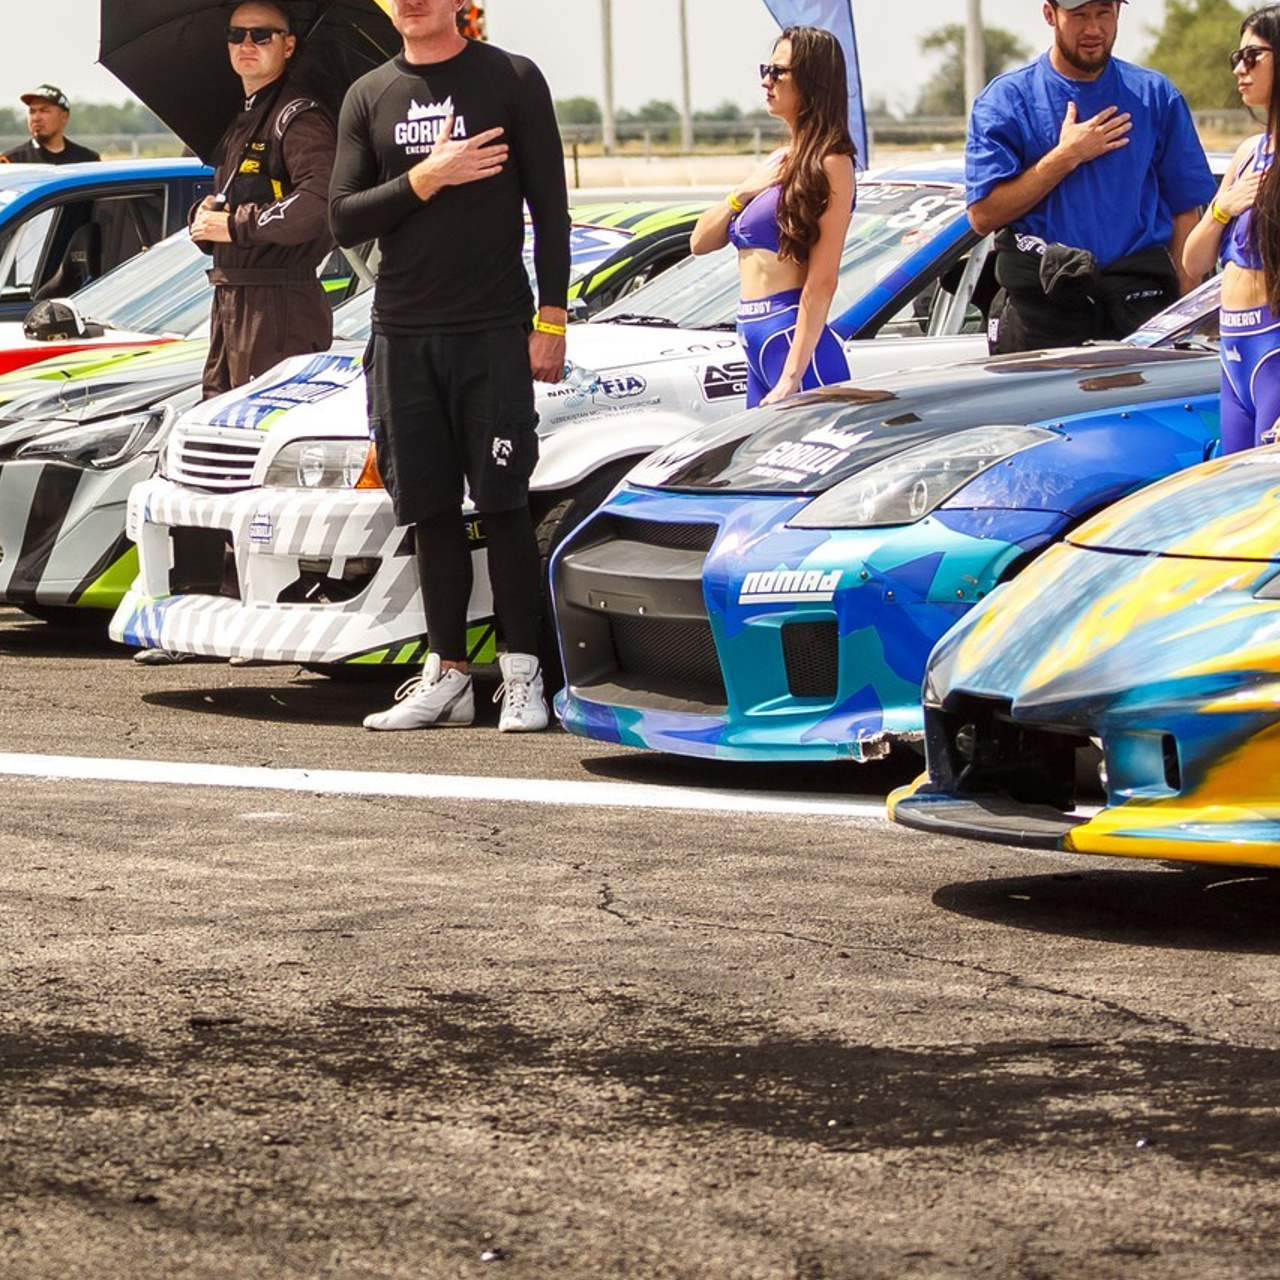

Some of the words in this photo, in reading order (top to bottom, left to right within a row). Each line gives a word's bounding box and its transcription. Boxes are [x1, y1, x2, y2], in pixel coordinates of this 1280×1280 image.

[395, 115, 467, 145] GORILA
[886, 195, 968, 230] 87
[755, 440, 851, 476] GORILLA
